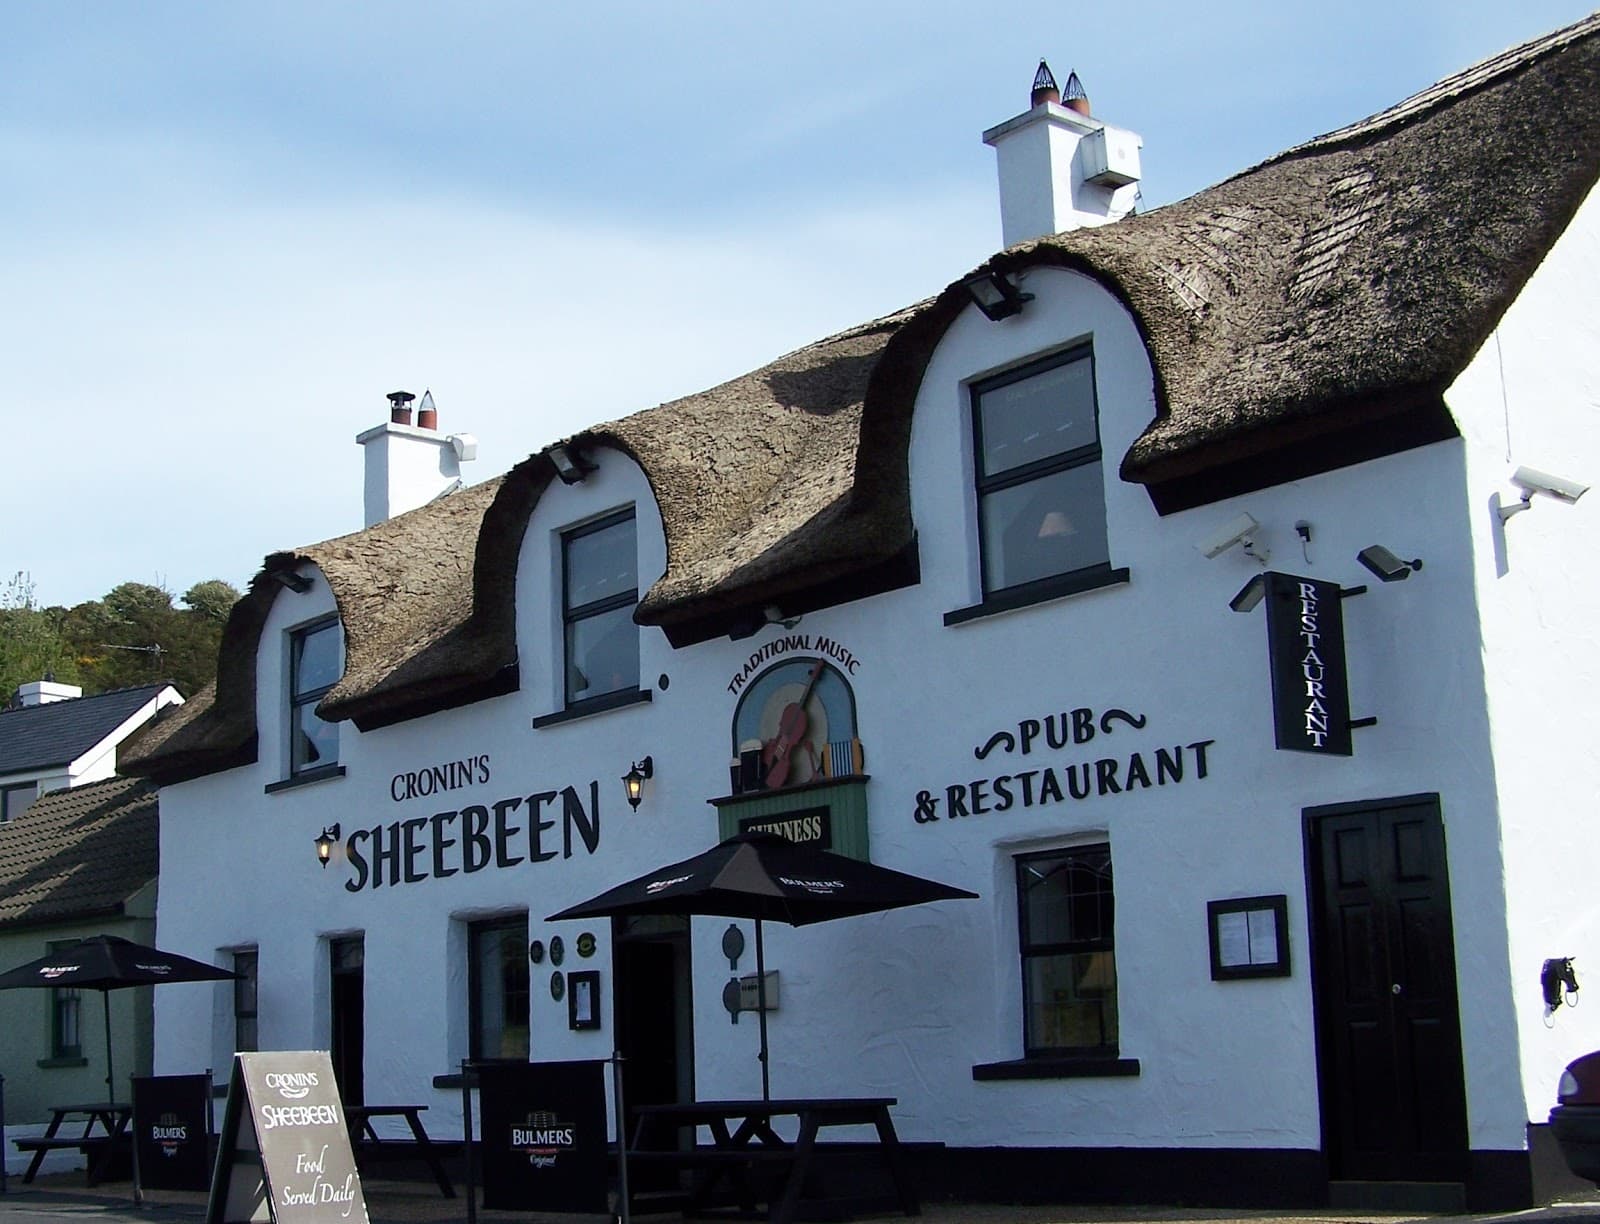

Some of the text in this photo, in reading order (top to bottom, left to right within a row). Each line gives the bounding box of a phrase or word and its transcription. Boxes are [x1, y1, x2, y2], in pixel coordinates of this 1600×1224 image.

[727, 634, 861, 696] TRADITIONAL MUSIC
[1298, 582, 1329, 747] RESTAURANT
[1019, 708, 1096, 755] PUB
[390, 754, 490, 802] CRONIN'S
[914, 740, 1216, 824] & RESTAURANT
[345, 781, 601, 893] SHEEBEEN
[152, 1125, 187, 1139] BULMERS
[261, 1104, 339, 1129] SHEEBEEN
[512, 1128, 573, 1145] BULMERS
[295, 1144, 329, 1174] Food
[281, 1173, 355, 1218] Served Daily
